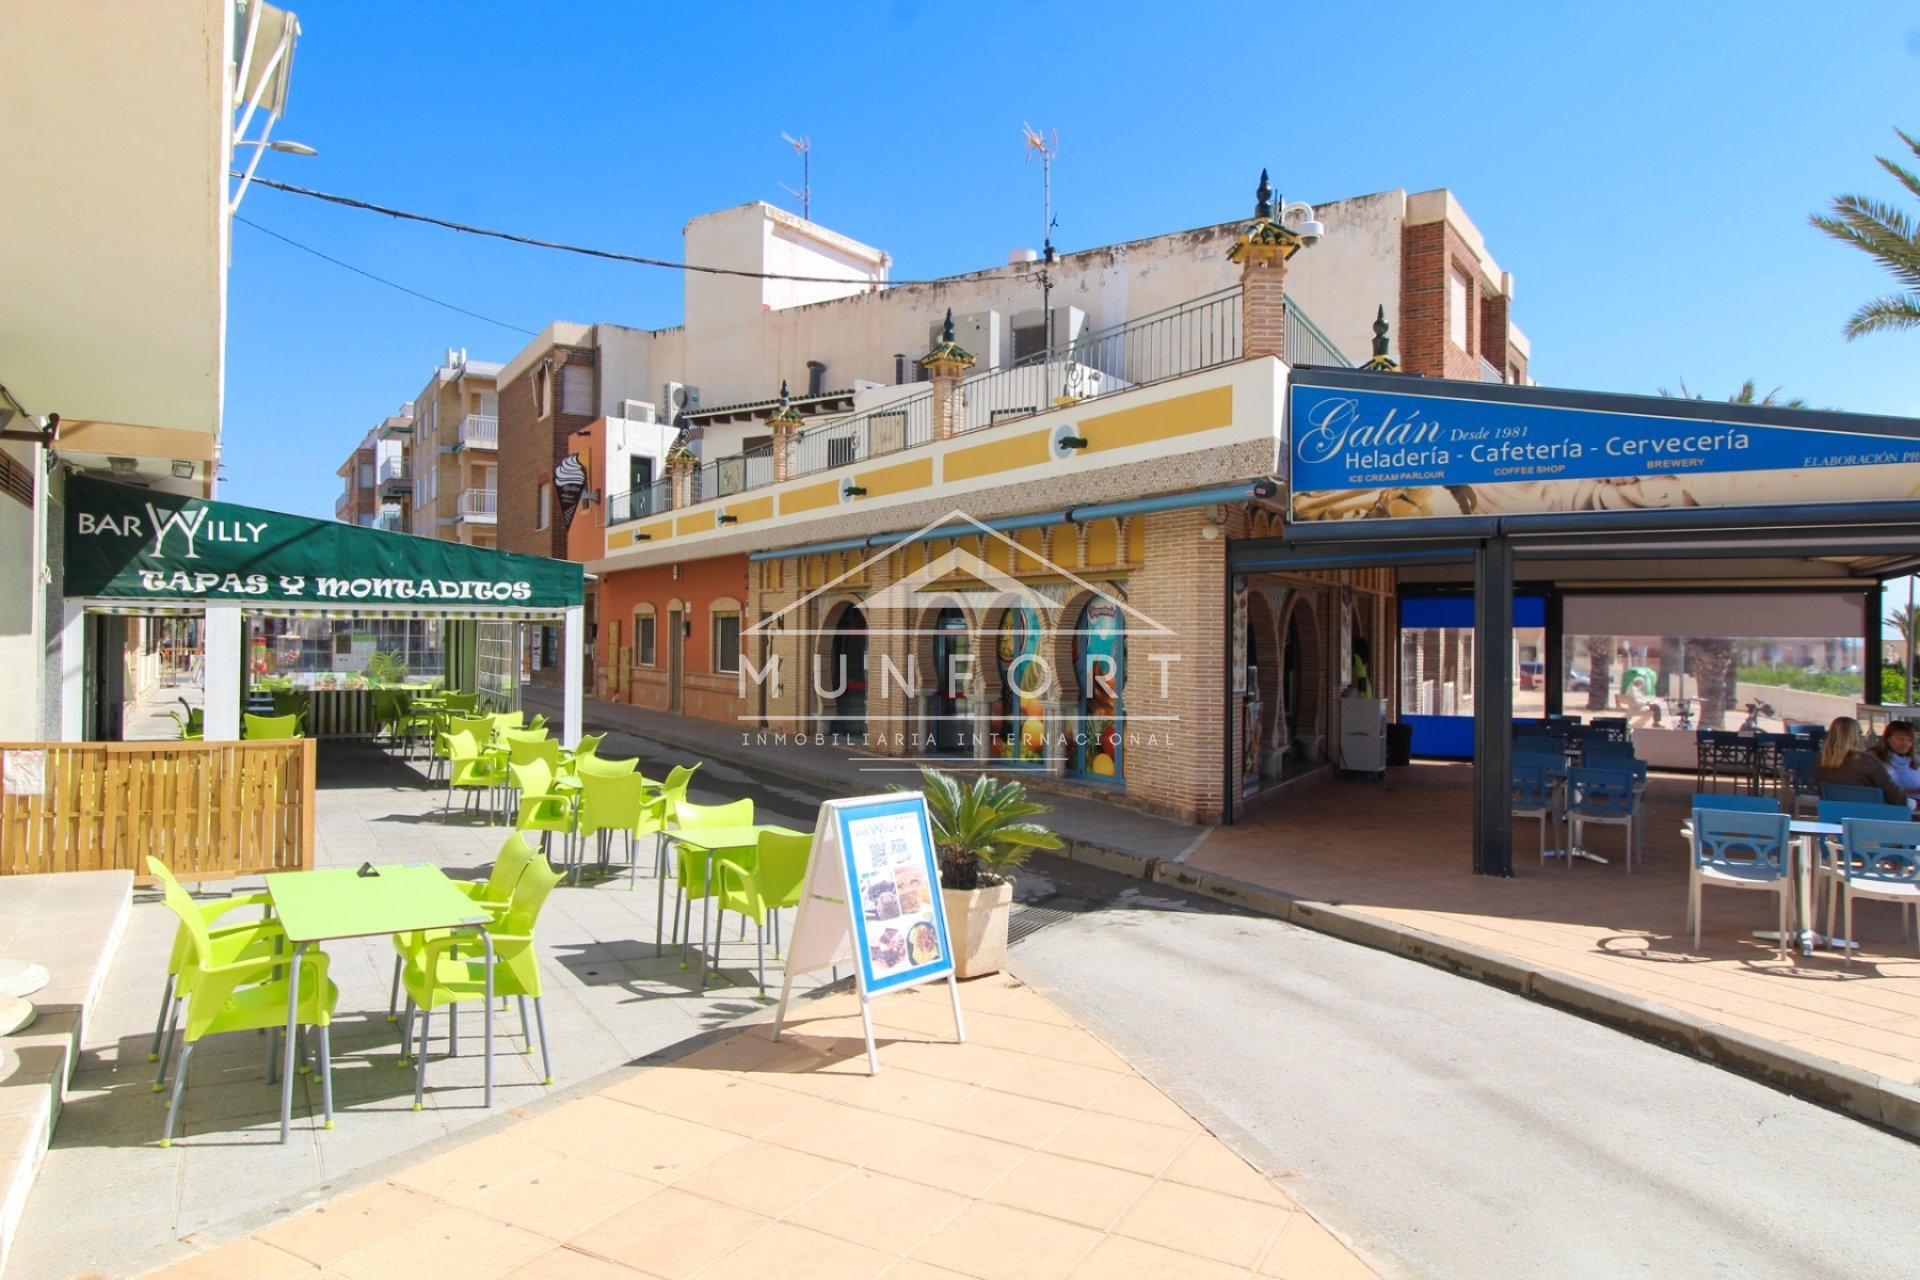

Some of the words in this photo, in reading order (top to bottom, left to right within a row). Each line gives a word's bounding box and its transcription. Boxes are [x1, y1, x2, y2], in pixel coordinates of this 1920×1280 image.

[1297, 398, 1446, 464] Galán
[1450, 427, 1491, 442] Desde
[1494, 425, 1529, 440] 1981
[1345, 448, 1450, 470] Heladería
[1470, 438, 1583, 464] Cafetería
[1605, 428, 1749, 457] Cervecería
[1646, 458, 1705, 469] BREWERY
[1803, 451, 1898, 468] ELABORACIÓN
[1348, 474, 1365, 483] ICE
[1367, 472, 1400, 482] CREAM
[1400, 470, 1445, 481] PARLOUR
[1493, 466, 1535, 476] COFFEE
[1536, 464, 1566, 475] SHOP
[79, 512, 143, 537] BAR
[145, 502, 268, 559] WILLY
[139, 569, 269, 595] TAPAS
[279, 575, 305, 595] Y
[315, 577, 532, 600] MONTADITOS
